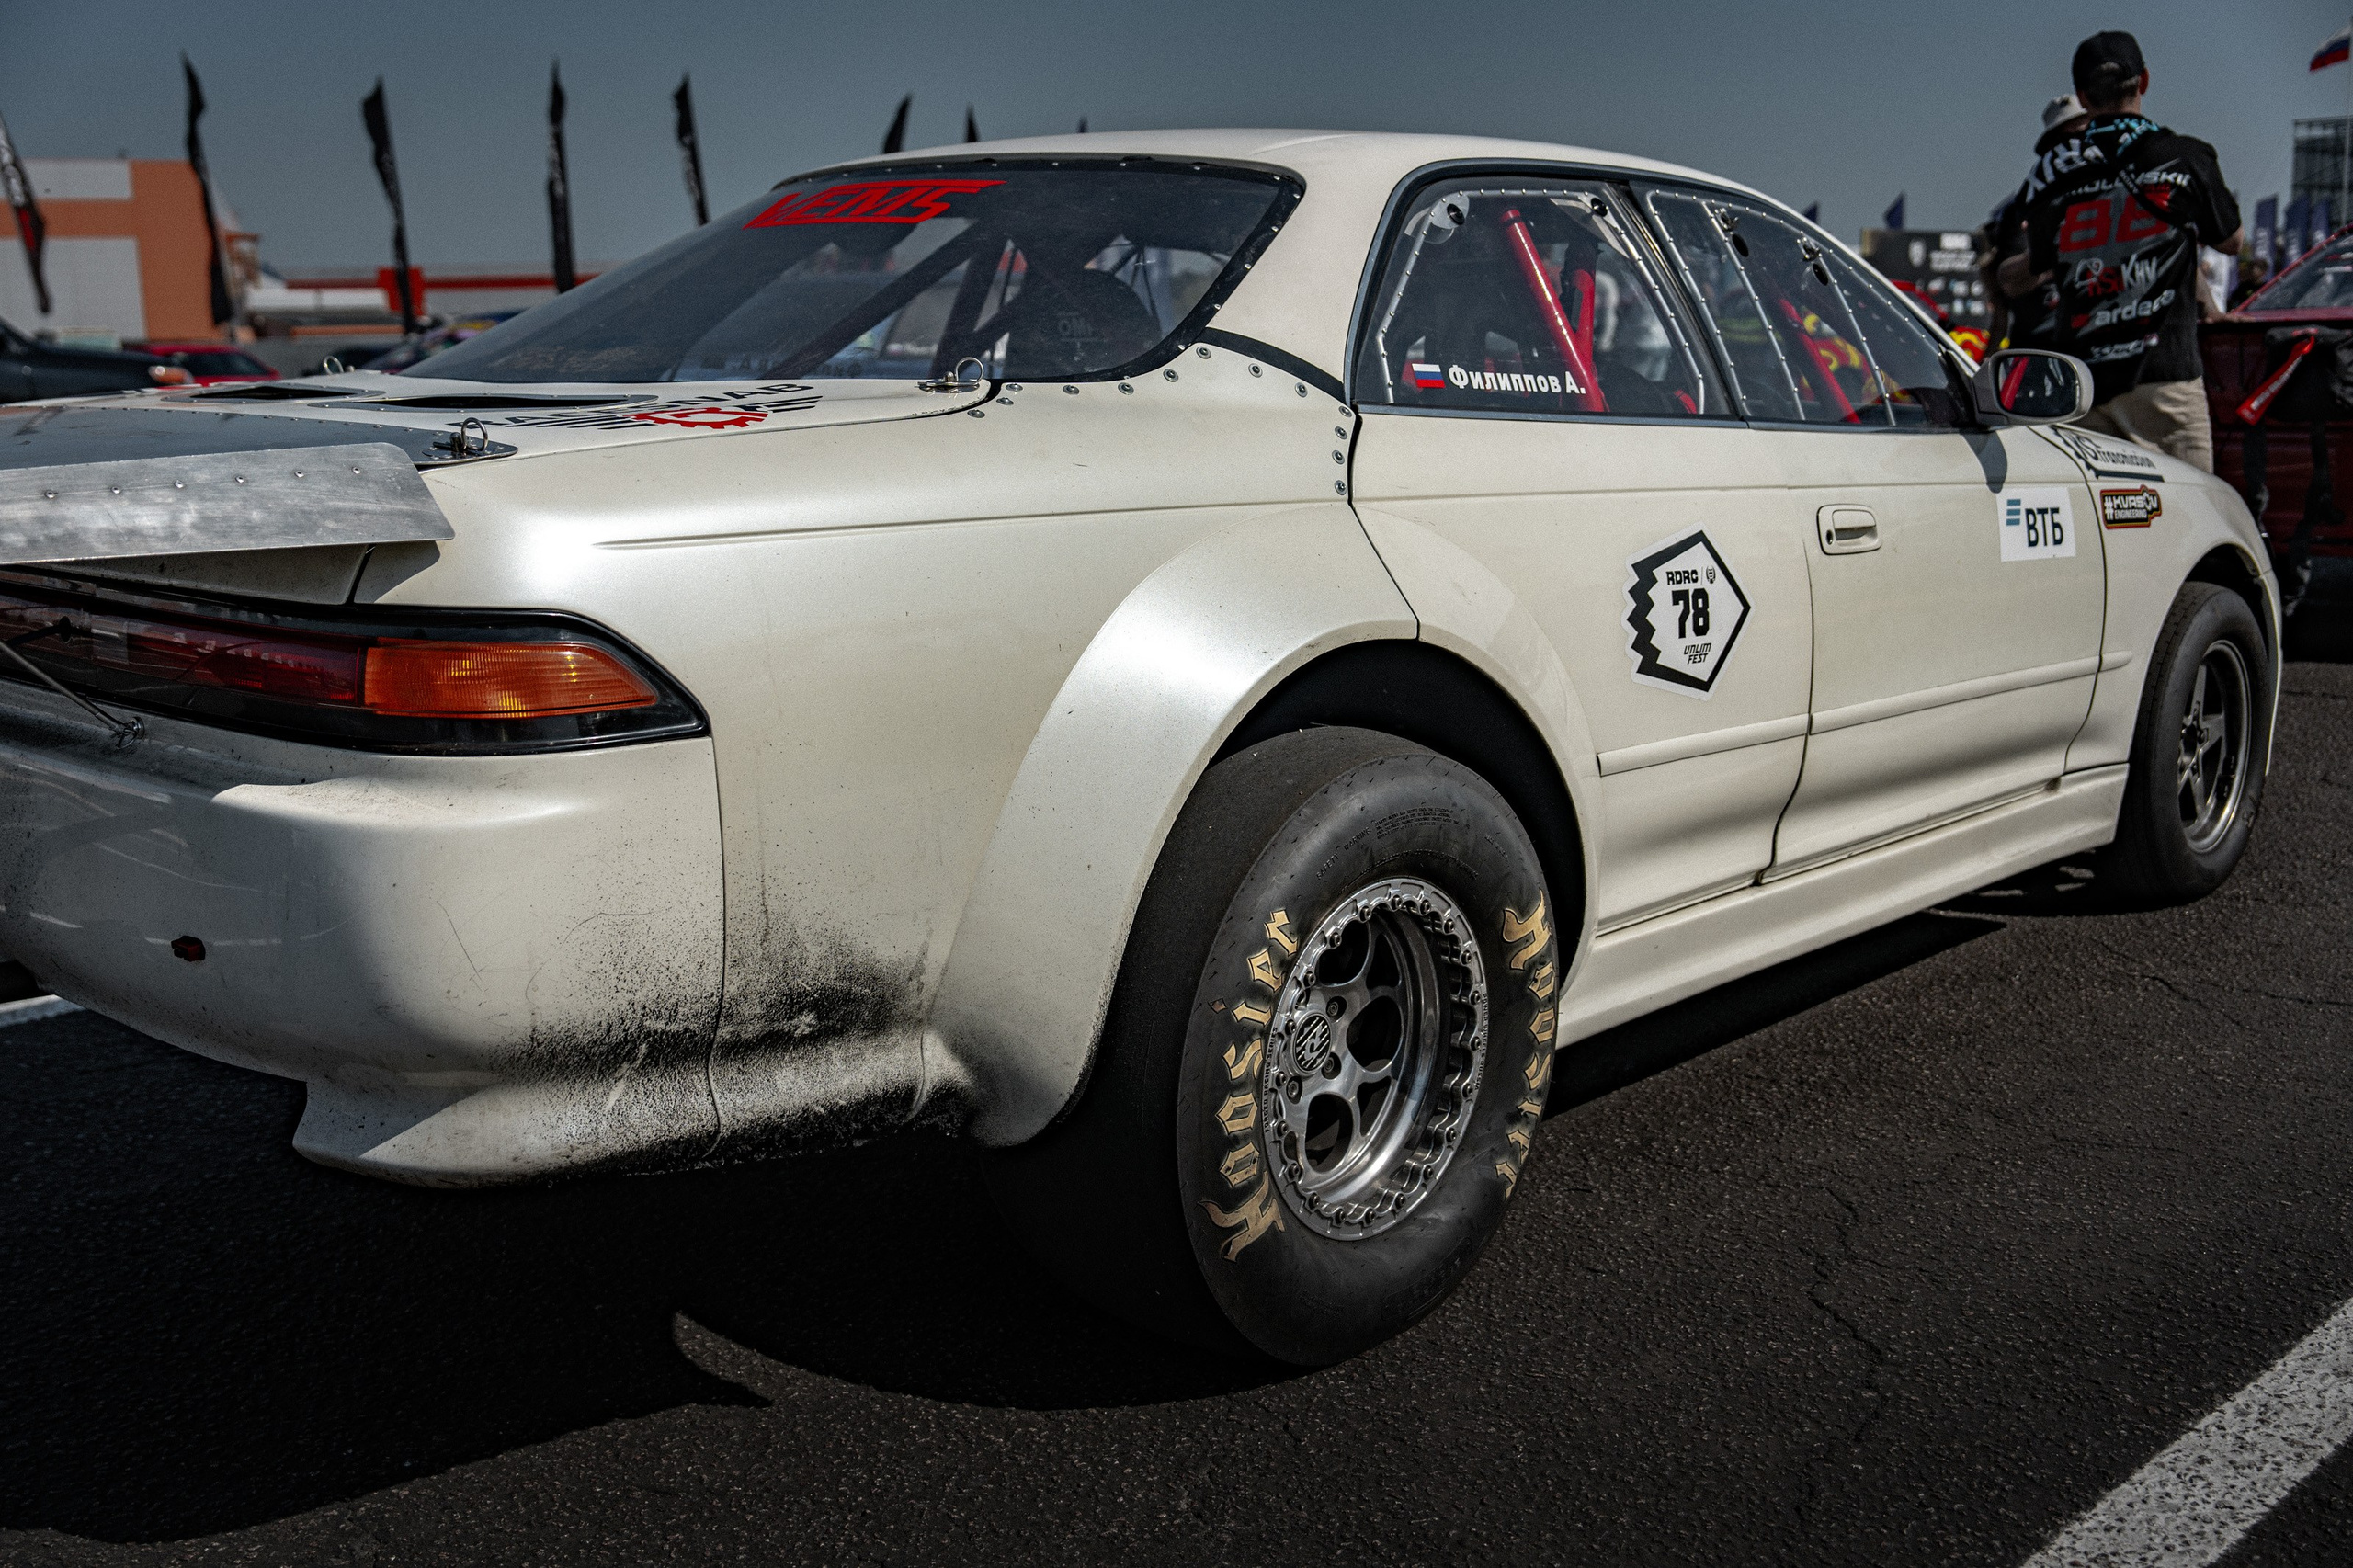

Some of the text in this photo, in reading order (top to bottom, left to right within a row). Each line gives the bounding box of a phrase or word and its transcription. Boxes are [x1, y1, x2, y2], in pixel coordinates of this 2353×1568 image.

[741, 179, 1007, 230] VEMS
[1448, 364, 1586, 394] Филиппов А.
[2024, 506, 2063, 548] ВТБ
[1665, 569, 1699, 585] RDRC
[1671, 587, 1710, 639] 78
[1683, 642, 1712, 655] UNLIM
[1687, 653, 1709, 665] FEST
[1262, 1026, 1279, 1133] FORGED RACING SERIES
